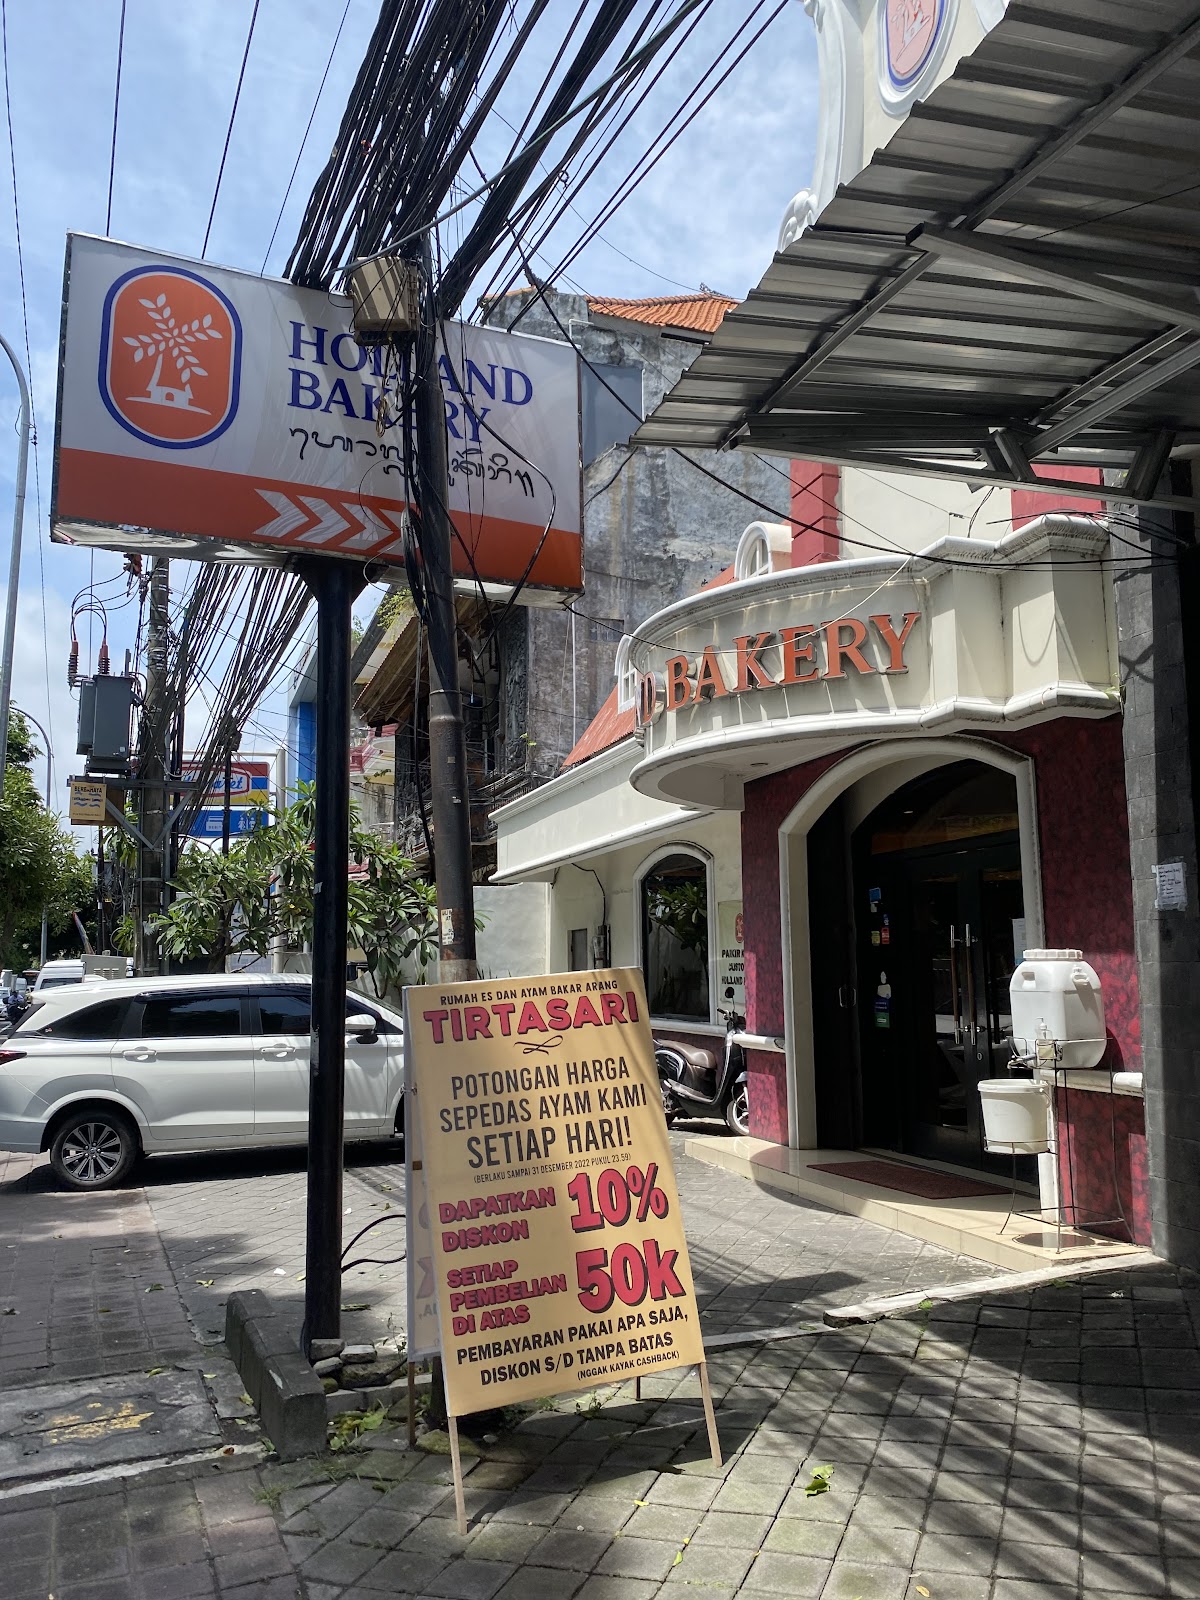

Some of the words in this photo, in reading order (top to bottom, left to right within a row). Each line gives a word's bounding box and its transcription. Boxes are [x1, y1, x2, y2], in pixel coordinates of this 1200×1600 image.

[288, 320, 534, 406] HOLAND
[287, 367, 491, 443] BAKRY
[665, 612, 922, 712] BAKERY
[721, 949, 740, 958] PARKIR
[728, 962, 745, 972] CUSTO
[440, 993, 478, 1006] RUMAH
[482, 991, 493, 1002] ES
[497, 989, 518, 1001] DAN
[521, 986, 548, 999] AYAM
[551, 983, 583, 996] BAKAR
[586, 980, 618, 992] ARANG
[423, 991, 640, 1044] TIRTASARI
[451, 1064, 560, 1100] POTONGAN
[566, 1056, 631, 1086] HARGA
[439, 1098, 532, 1133] SEPEDAS
[539, 1090, 592, 1120] AYAM
[597, 1083, 648, 1111] KAMI
[467, 1126, 556, 1169] SETIAP
[565, 1115, 634, 1155] HARI!
[473, 1170, 506, 1184] (BERLAKU
[507, 1167, 531, 1179] SAMPAI
[531, 1166, 539, 1175] 31
[540, 1162, 574, 1174] DESEMBER
[574, 1159, 590, 1169] 2022
[591, 1156, 611, 1166] PUKUL
[612, 1152, 632, 1163] 23.59)
[439, 1187, 557, 1224] DAPATKAN
[567, 1162, 670, 1234] 10%
[441, 1219, 530, 1253] DISKON
[446, 1259, 519, 1288] SETIAP
[449, 1273, 568, 1312] PEMBELIAN
[575, 1238, 687, 1314] 50k
[452, 1314, 476, 1336] DI
[479, 1304, 531, 1333] ATAS
[456, 1329, 565, 1365] PEMBAYARAN
[568, 1321, 613, 1343] PAKAI
[617, 1314, 646, 1333] APA
[648, 1305, 689, 1325] SAJA,
[480, 1359, 541, 1386] DISKON
[544, 1353, 574, 1375] S/D
[576, 1340, 626, 1365] TANPA
[628, 1331, 674, 1354] BATAS
[576, 1363, 608, 1381] (NGGAK
[609, 1358, 635, 1374] KAYAK
[636, 1350, 681, 1369] CASHBACK)
